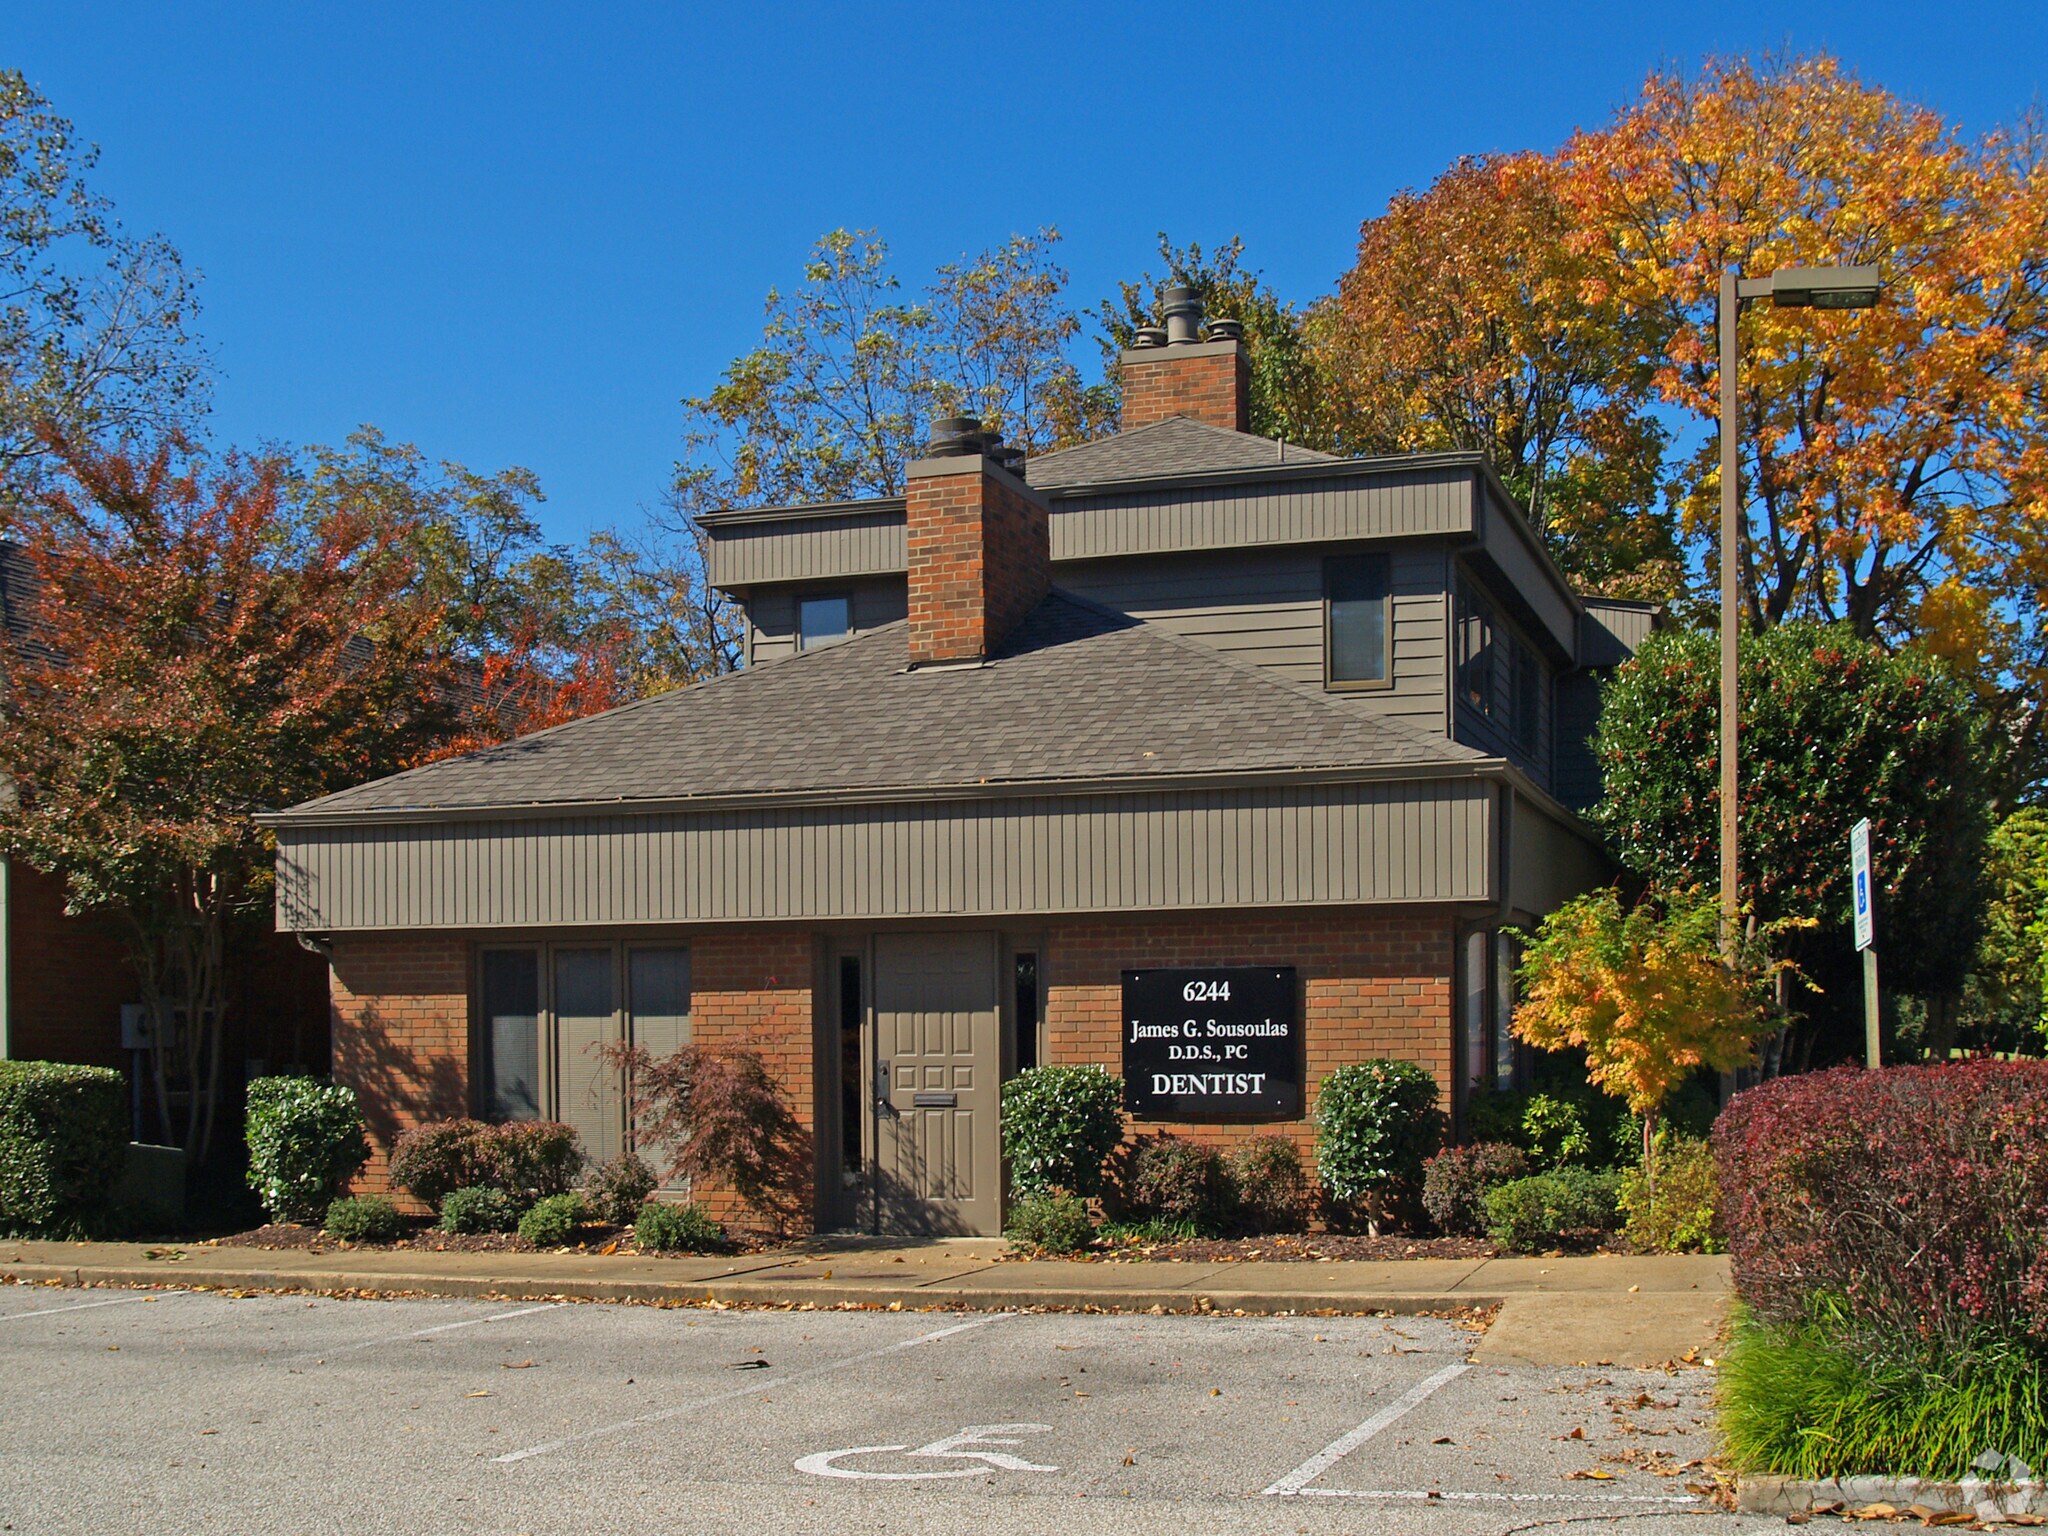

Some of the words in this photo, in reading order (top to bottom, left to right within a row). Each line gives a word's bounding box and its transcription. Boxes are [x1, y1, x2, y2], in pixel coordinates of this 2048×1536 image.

[1182, 980, 1231, 1002] 6244
[1130, 1020, 1179, 1043] James
[1183, 1019, 1202, 1038] G.
[1206, 1018, 1289, 1038] Sousoulas
[1168, 1045, 1222, 1063] D.D.S.,
[1224, 1044, 1248, 1060] PC
[1151, 1072, 1266, 1095] DENTIST
